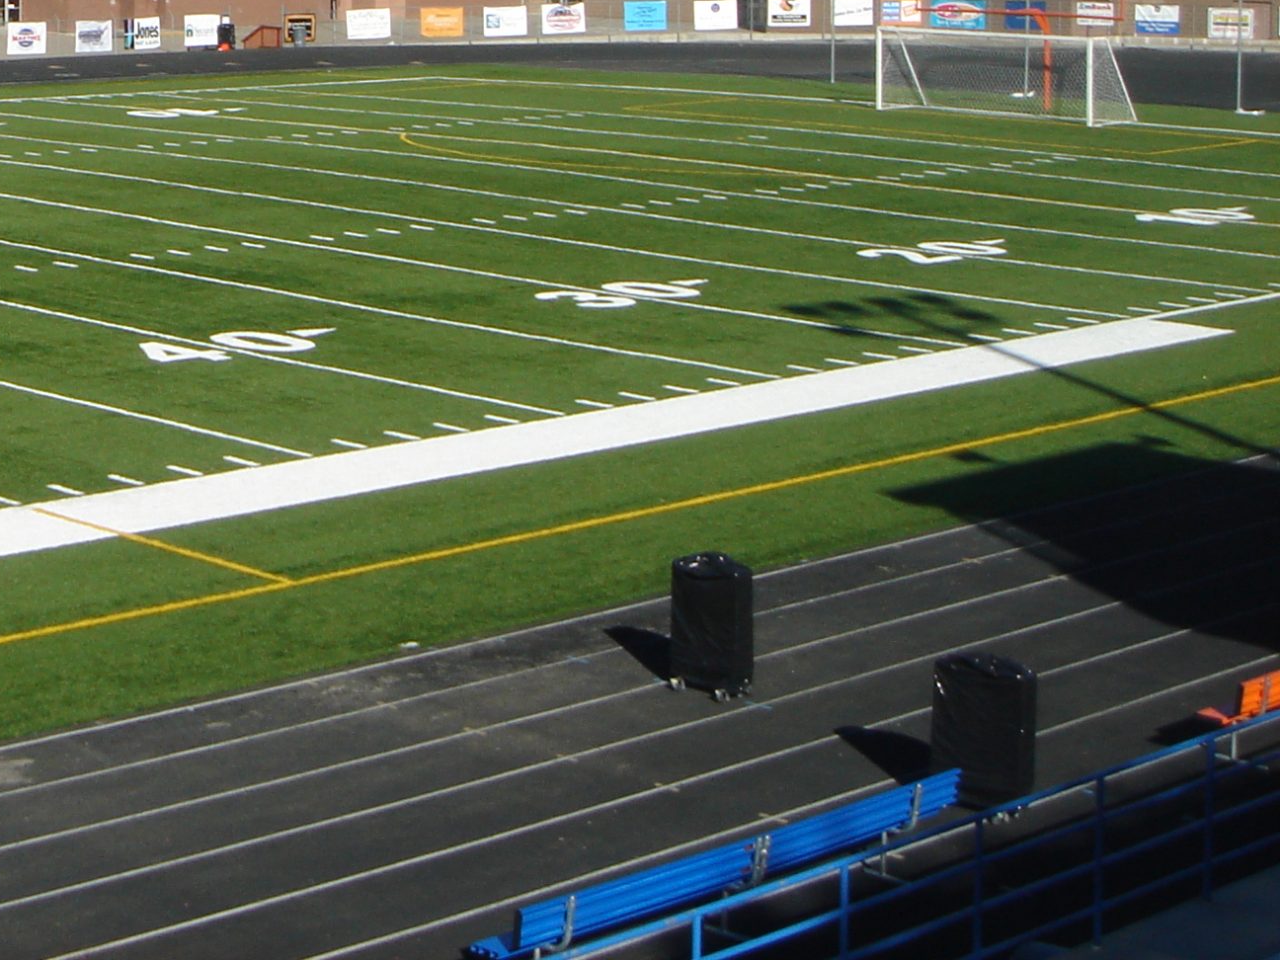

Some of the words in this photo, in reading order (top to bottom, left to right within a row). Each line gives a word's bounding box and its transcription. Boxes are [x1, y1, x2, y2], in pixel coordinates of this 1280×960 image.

[135, 21, 160, 39] Jones
[1135, 207, 1255, 226] 10
[857, 240, 1006, 266] 20
[535, 281, 701, 309] 30
[139, 331, 317, 365] 40
